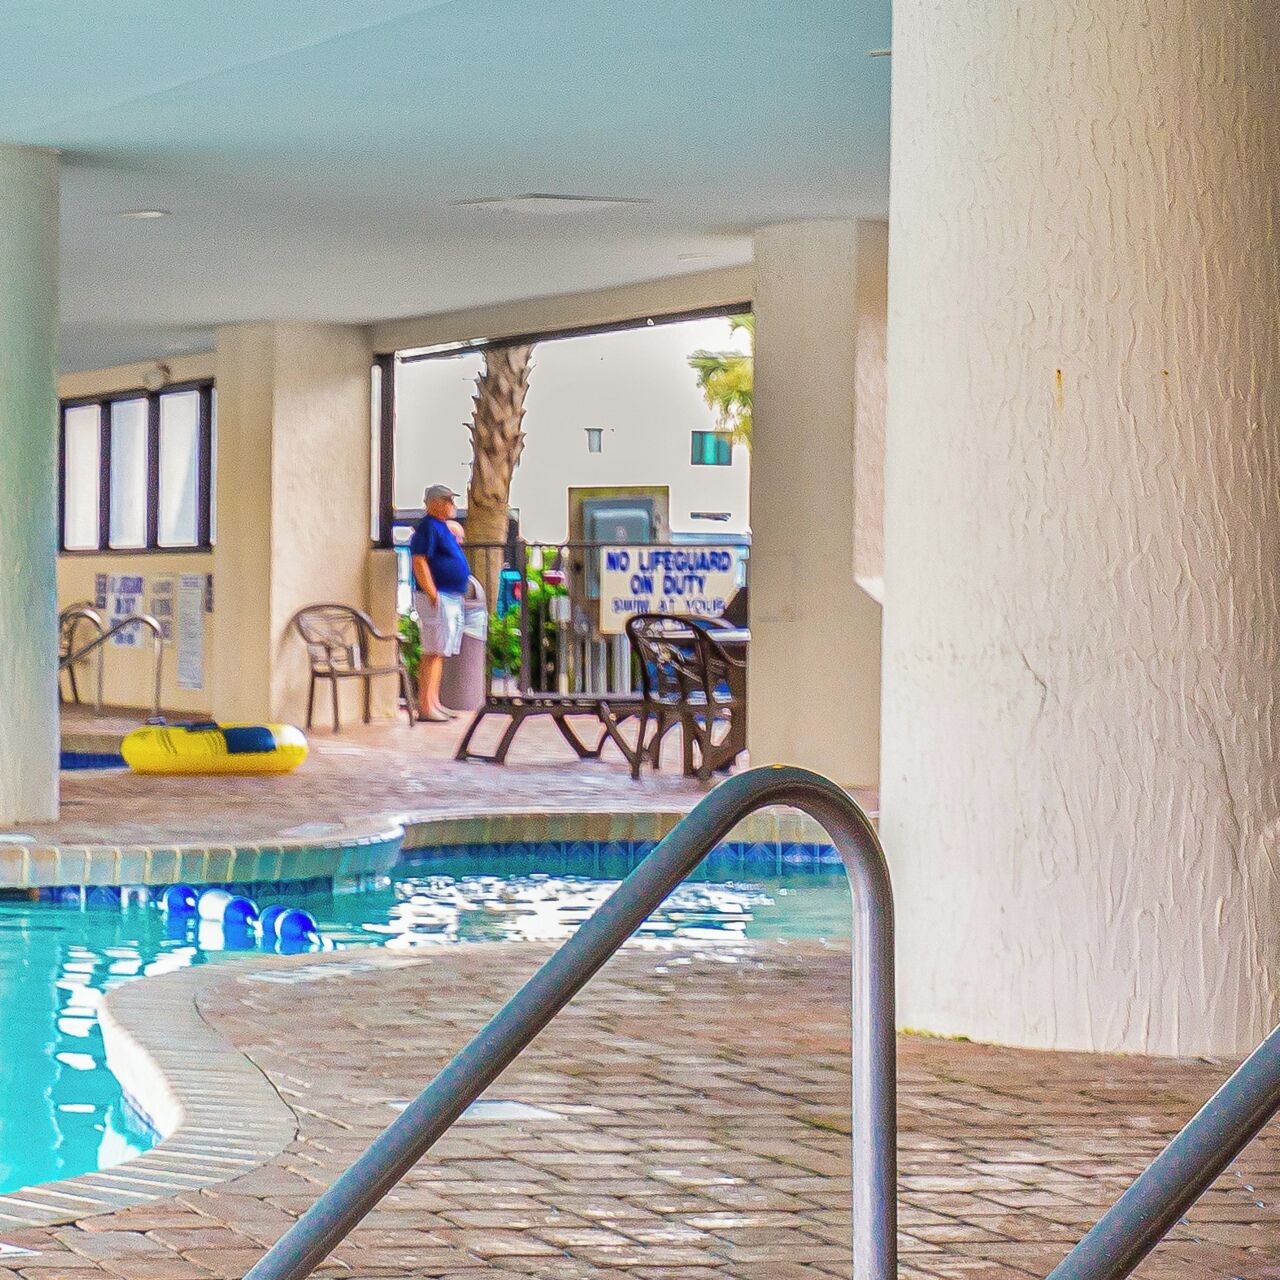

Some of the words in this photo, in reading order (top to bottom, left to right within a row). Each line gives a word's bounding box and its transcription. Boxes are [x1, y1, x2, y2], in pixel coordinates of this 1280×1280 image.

[606, 551, 630, 571] NO
[639, 551, 732, 572] LIFEGUARD
[630, 575, 653, 595] ON
[663, 575, 706, 595] DUTY
[659, 599, 674, 613] AT
